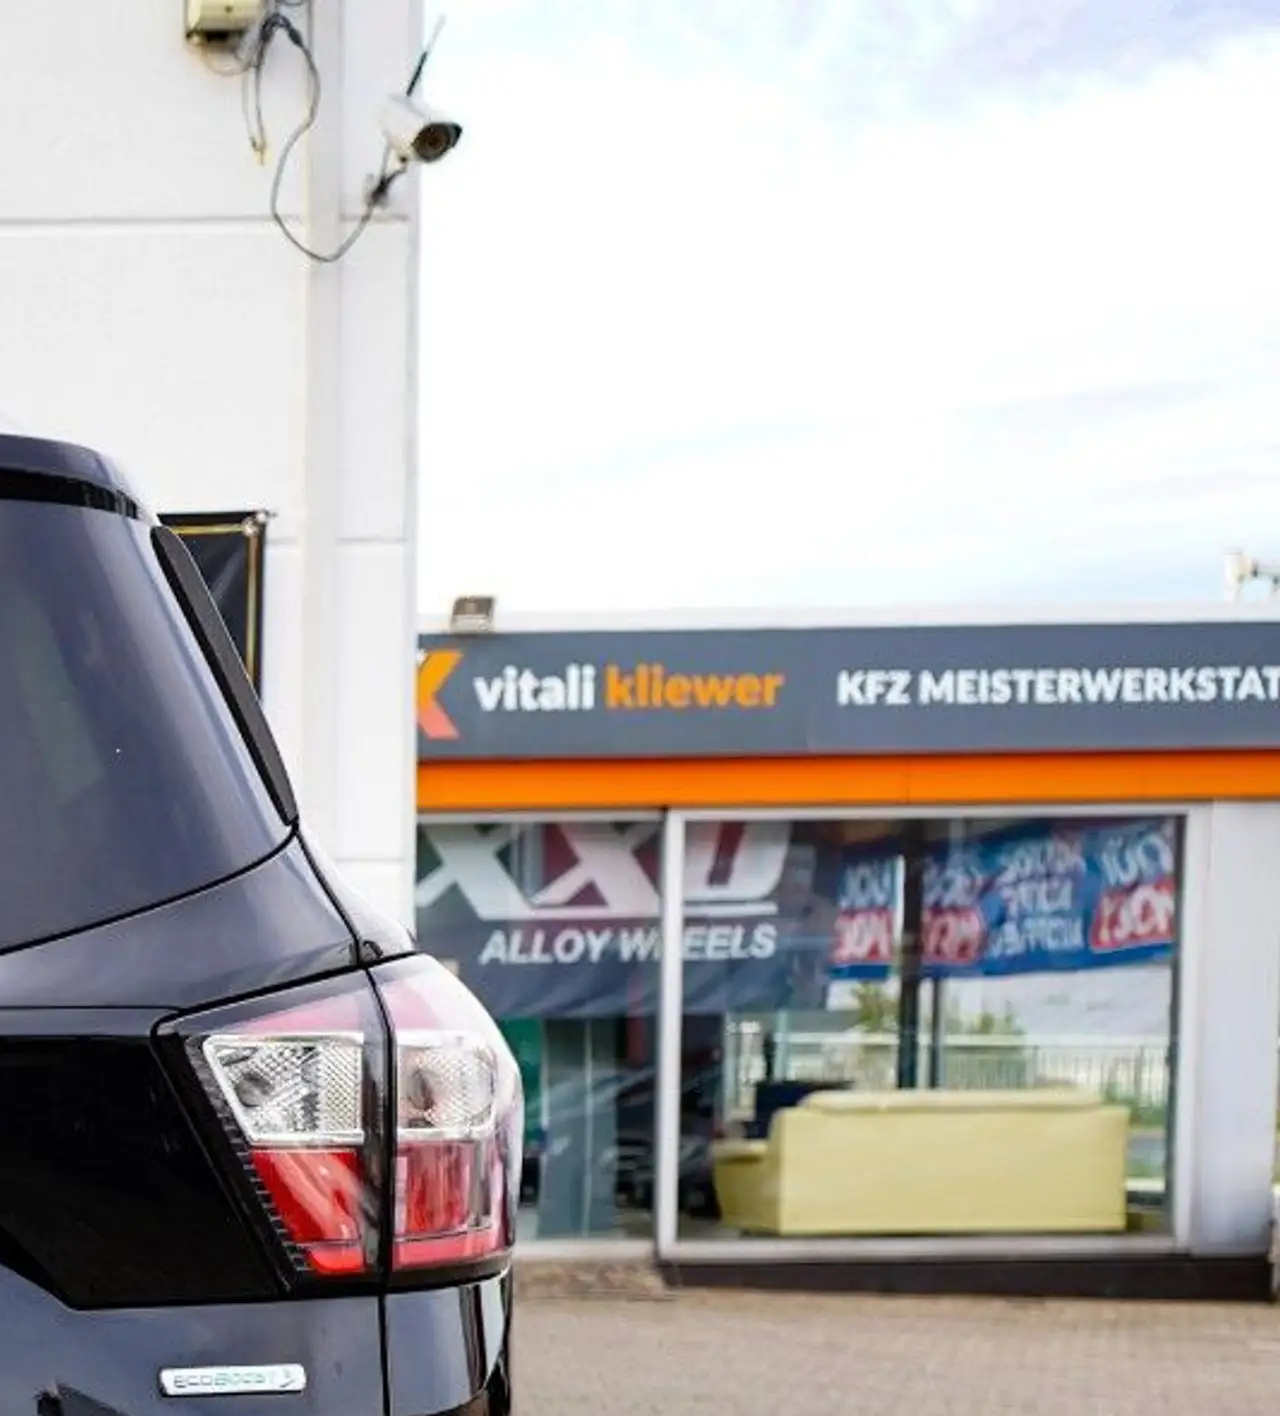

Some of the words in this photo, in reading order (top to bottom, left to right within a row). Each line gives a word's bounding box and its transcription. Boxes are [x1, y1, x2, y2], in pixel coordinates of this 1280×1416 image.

[473, 664, 596, 711] vitali
[605, 664, 784, 709] kliewer
[837, 669, 910, 705] KFZ
[478, 929, 613, 966] ALLOY
[620, 924, 778, 963] WEELS
